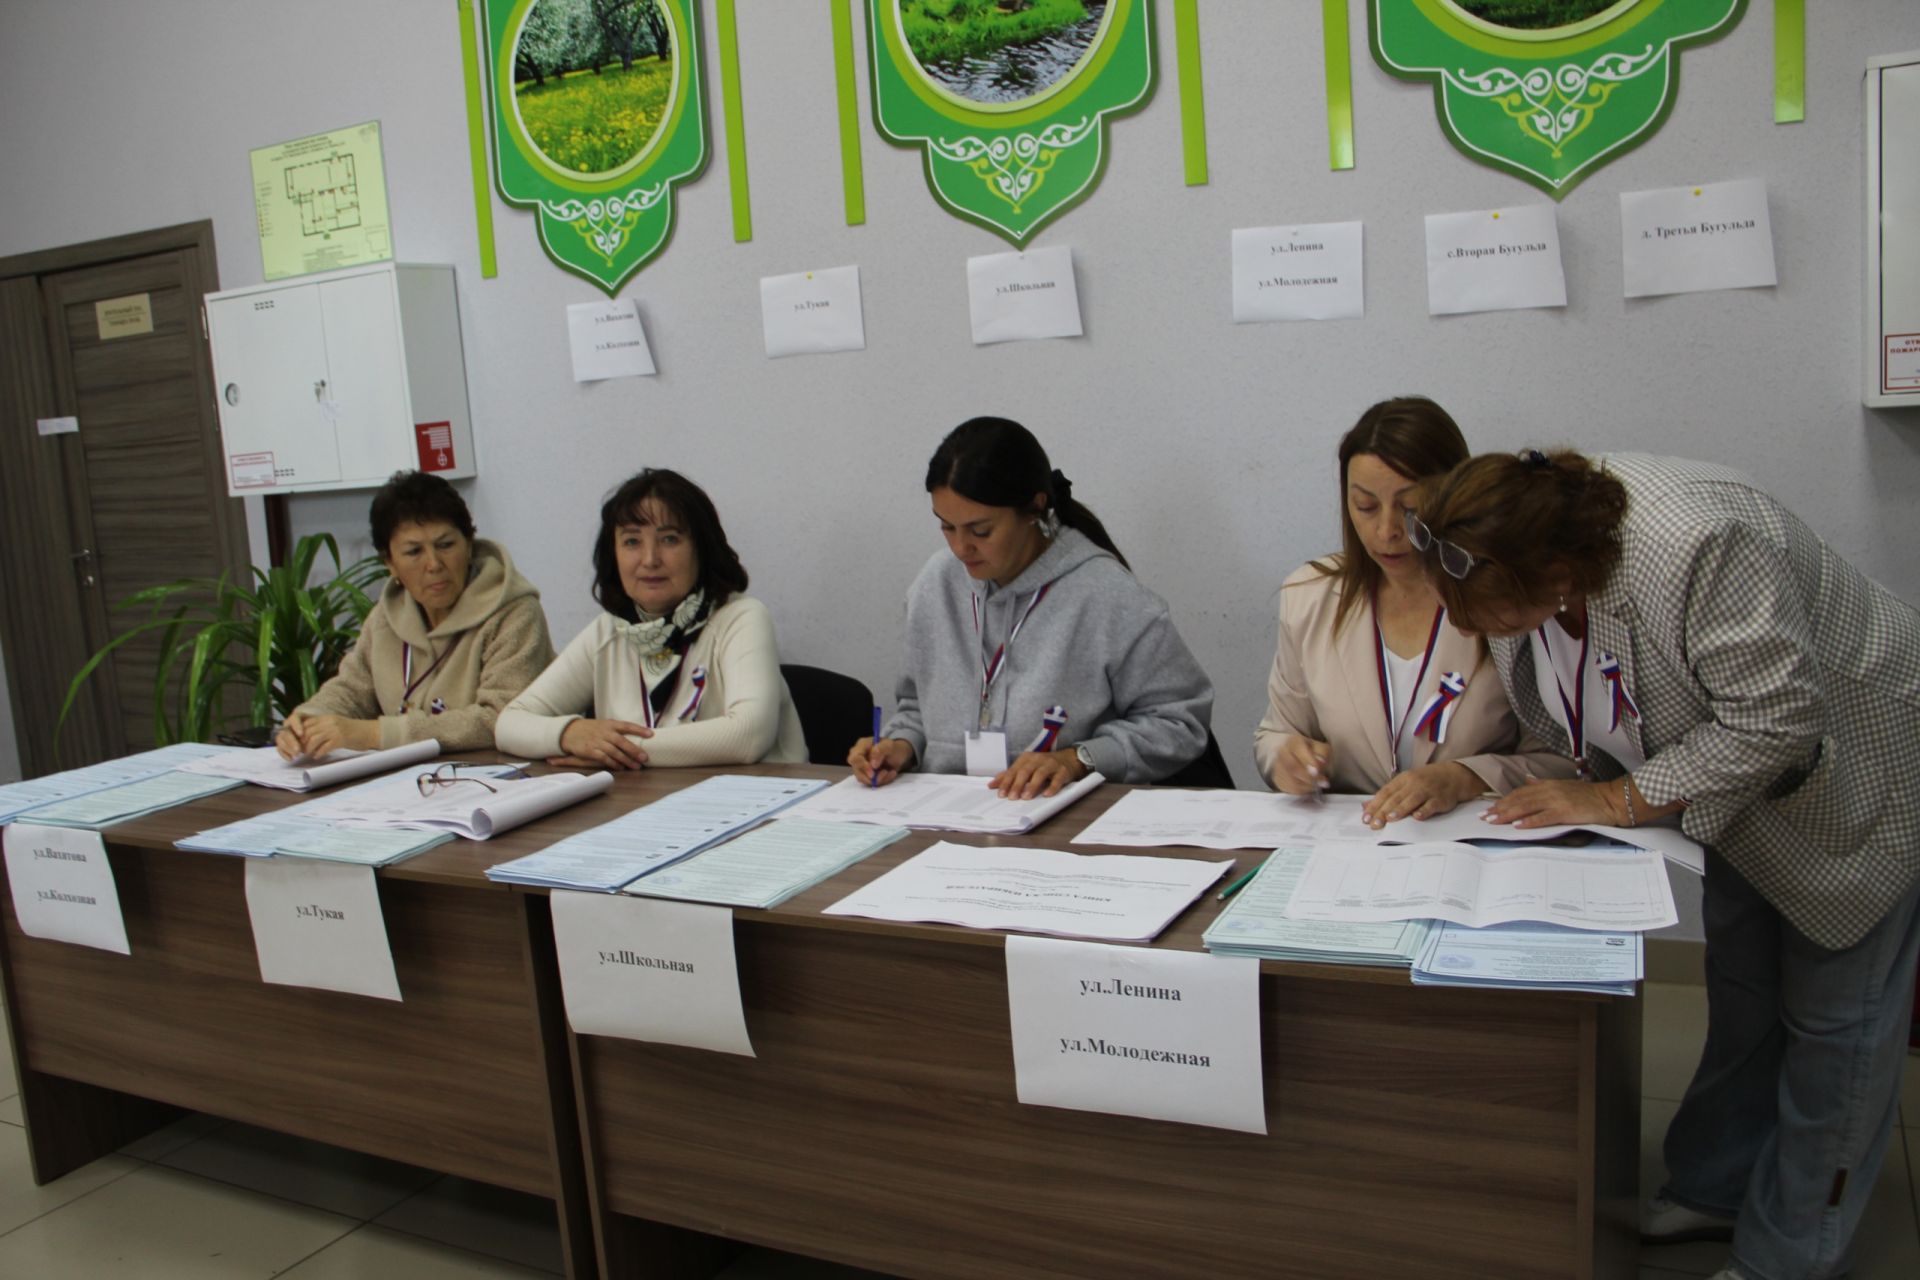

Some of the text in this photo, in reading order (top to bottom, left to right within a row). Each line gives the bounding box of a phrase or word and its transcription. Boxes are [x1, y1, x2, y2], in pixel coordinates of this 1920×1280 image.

[1654, 224, 1697, 239] Третья
[1270, 242, 1324, 256] ул.Ленина
[1258, 276, 1338, 290] ул.Молодежная
[1890, 346, 1920, 354] ПОЖАР
[296, 904, 345, 920] ул.Тукая
[598, 950, 694, 974] ул.Школьная
[1080, 978, 1182, 1002] ул.Ленина
[1060, 1037, 1211, 1068] ул.Молодежная
